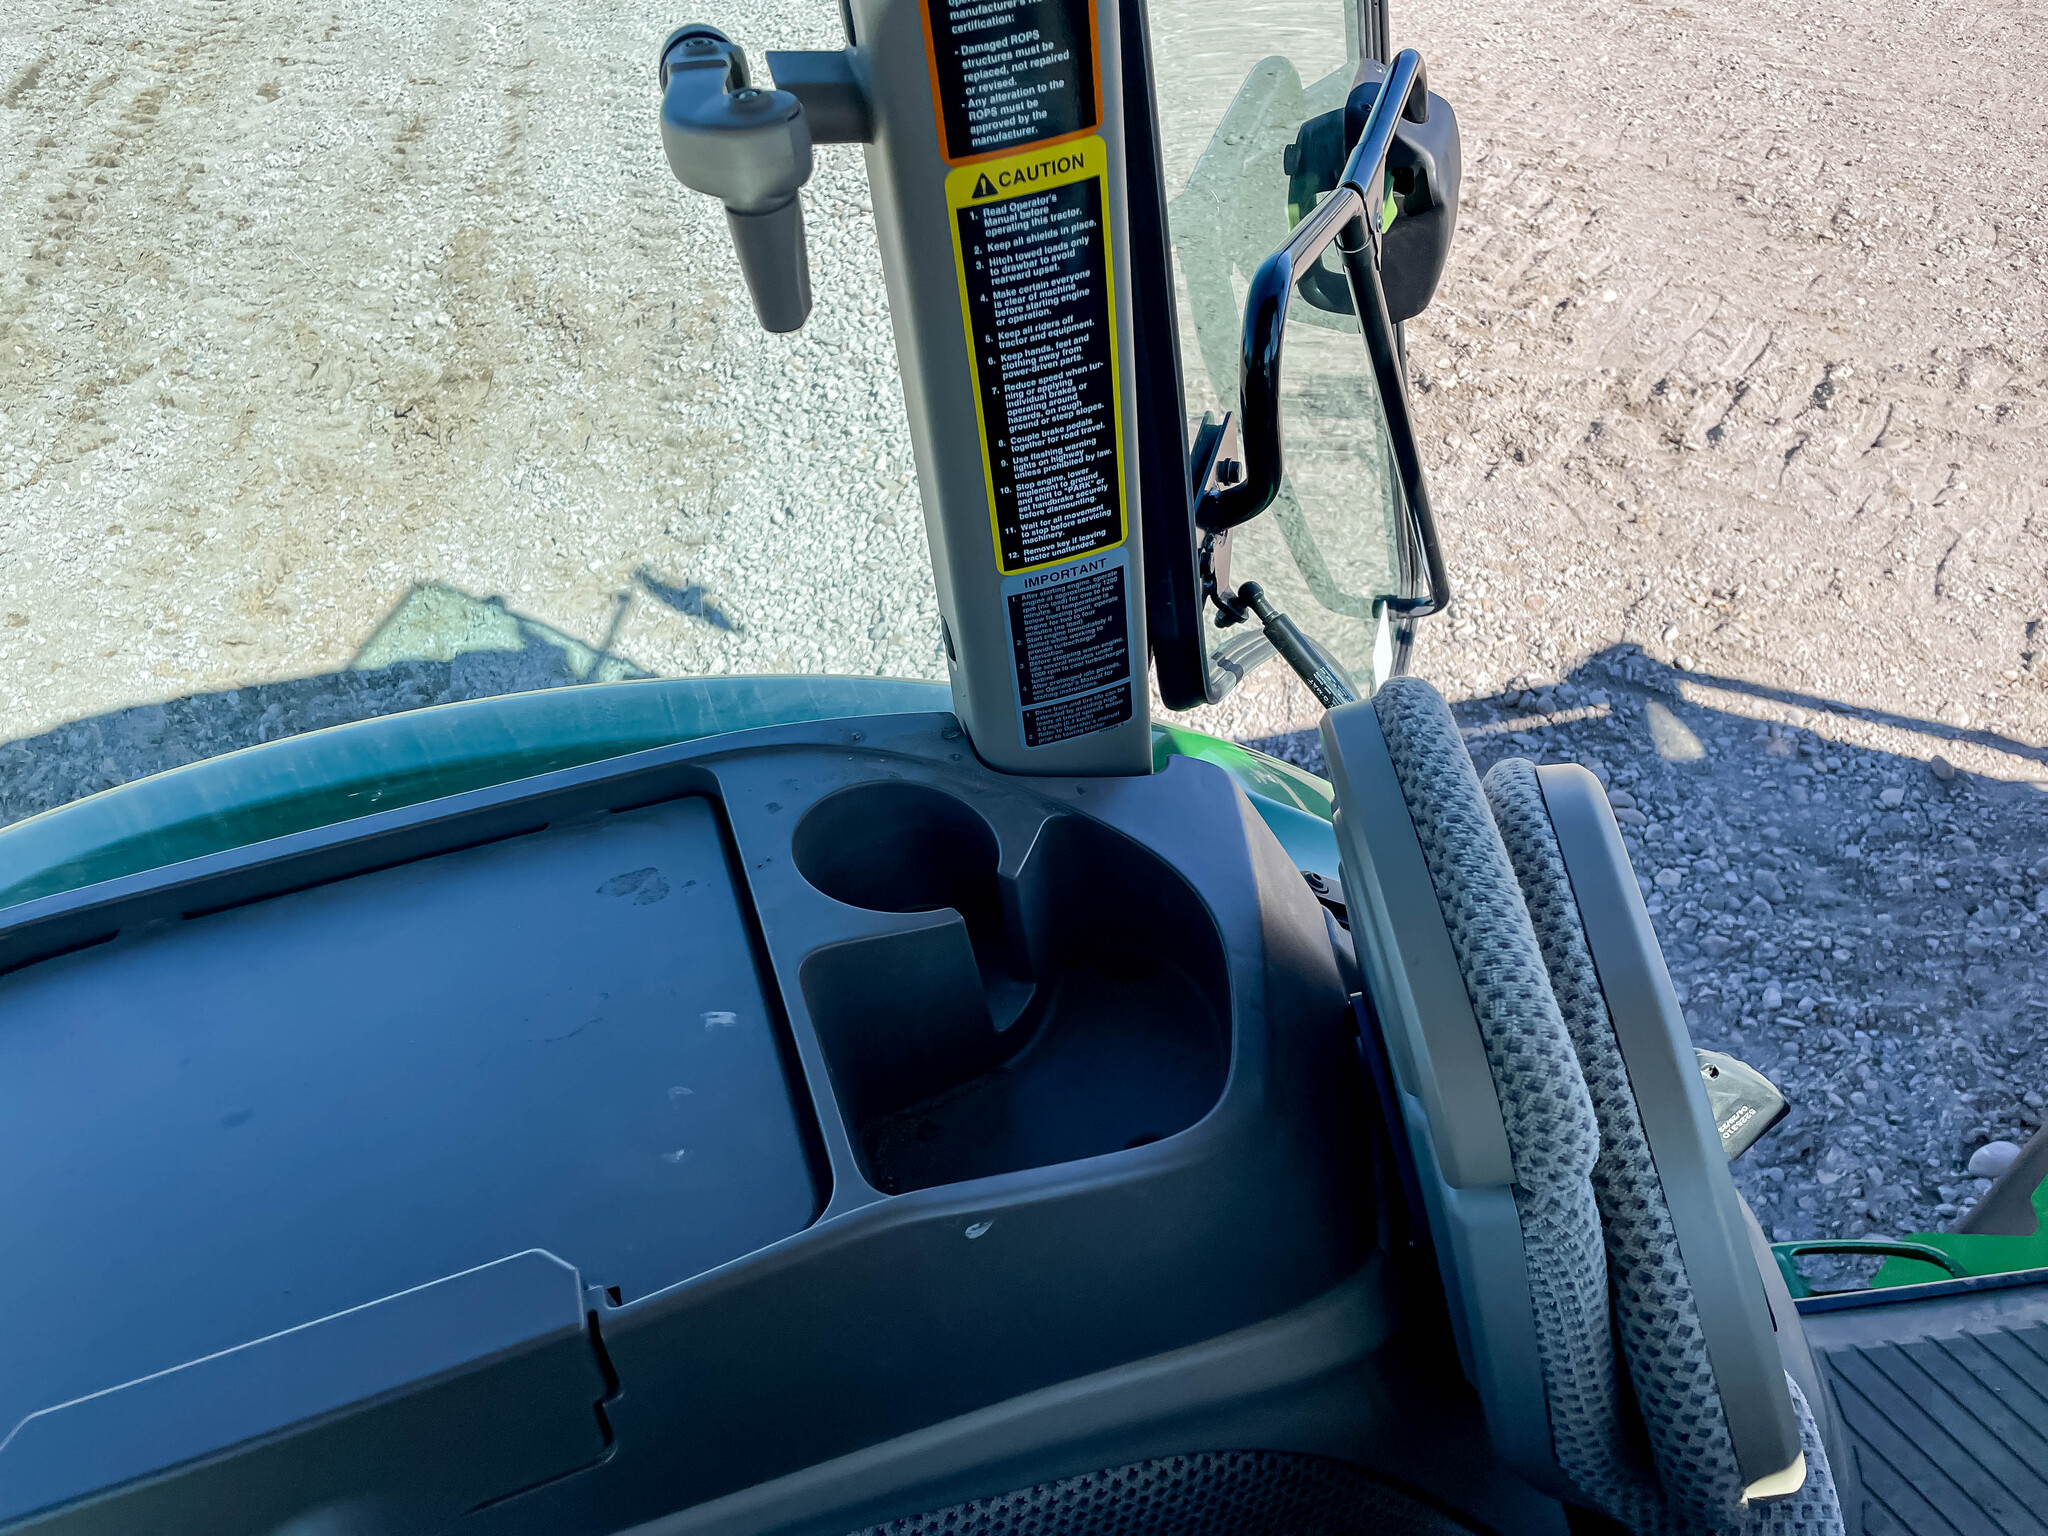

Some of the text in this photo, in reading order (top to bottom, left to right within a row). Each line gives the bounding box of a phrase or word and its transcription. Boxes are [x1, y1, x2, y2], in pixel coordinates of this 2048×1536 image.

[950, 0, 1026, 19] manufacturers
[952, 14, 1014, 34] certification:
[961, 30, 1040, 56] Damaged ROPS
[962, 42, 1054, 69] structures must be
[1012, 60, 1028, 72] not
[1030, 50, 1069, 68] repaired
[966, 77, 1017, 95] or revised.
[968, 80, 1064, 108] Any alteration to the
[969, 99, 1039, 120] ROPS must be
[971, 110, 1047, 135] approved by the
[972, 126, 1038, 146] manufacturer.
[999, 153, 1084, 187] CAUTION
[970, 211, 978, 220] 1.
[983, 204, 1007, 217] Read
[984, 207, 1049, 227] Manual before
[986, 208, 1082, 237] operating this tractor.
[974, 246, 982, 255] 2.
[987, 241, 1011, 252] Keep
[1026, 229, 1058, 244] shields
[1071, 220, 1096, 234] place.
[976, 236, 1089, 270] 3. Hitch towed loads only
[990, 248, 1076, 276] to drawbar to avoid
[980, 270, 1090, 302] 4. Make certain everyone
[991, 263, 1060, 285] rearward upset.
[994, 282, 1076, 309] is clear of machine
[995, 289, 1090, 318] before starting engine
[985, 335, 993, 343] 5.
[998, 330, 1021, 342] Keep
[1035, 320, 1060, 332] riders
[1062, 315, 1073, 325] off
[1008, 309, 1052, 324] operation.
[999, 319, 1094, 349] tractor and equipment.
[988, 357, 996, 365] 6.
[1000, 352, 1023, 362] Keep
[1056, 339, 1072, 349] feet
[1073, 333, 1089, 345] and
[1002, 346, 1082, 370] clothing away from
[1060, 354, 1084, 367] parts.
[992, 387, 1000, 395] 7.
[1004, 380, 1036, 392] Reduce
[1038, 371, 1064, 385] speed
[1065, 366, 1088, 377] when
[1005, 379, 1073, 400] ning or applying
[1006, 392, 1047, 408] individual
[1048, 386, 1077, 398] brakes
[1007, 392, 1078, 419] operating around
[1044, 408, 1056, 416] on
[1058, 400, 1082, 412] rough
[1009, 403, 1104, 434] ground or steep slopes.
[1010, 433, 1040, 446] Couple
[1041, 427, 1064, 437] brake
[1066, 418, 1093, 432] pedals
[1011, 422, 1105, 452] together for road travel.
[1012, 456, 1029, 464] Use
[1030, 448, 1063, 460] flashing
[1065, 438, 1096, 451] warning
[1013, 462, 1036, 472] lights
[1051, 450, 1084, 463] highway
[1014, 468, 1041, 479] unless
[1043, 456, 1084, 474] prohibited
[1097, 449, 1112, 458] law.
[1000, 486, 1012, 494] 10.
[1016, 482, 1035, 491] Stop
[1068, 468, 1089, 478] lower
[1017, 483, 1058, 498] implement
[1070, 471, 1098, 486] ground
[1018, 484, 1108, 513] set handbrake securely
[1018, 496, 1033, 506] and
[1035, 492, 1052, 502] shift
[1019, 496, 1096, 520] before dismounting.
[1020, 522, 1038, 531] Wait
[1064, 504, 1104, 520] movement
[1032, 527, 1049, 536] stop
[1050, 520, 1075, 531] before
[1077, 510, 1112, 524] servicing
[1022, 531, 1065, 545] machinery.
[1024, 544, 1055, 556] Remove
[1056, 540, 1070, 548] key
[1079, 530, 1106, 542] leaving
[1024, 552, 1050, 562] tractor
[1024, 558, 1107, 588] IMPORTANT
[1722, 1108, 1756, 1139] 5225310
